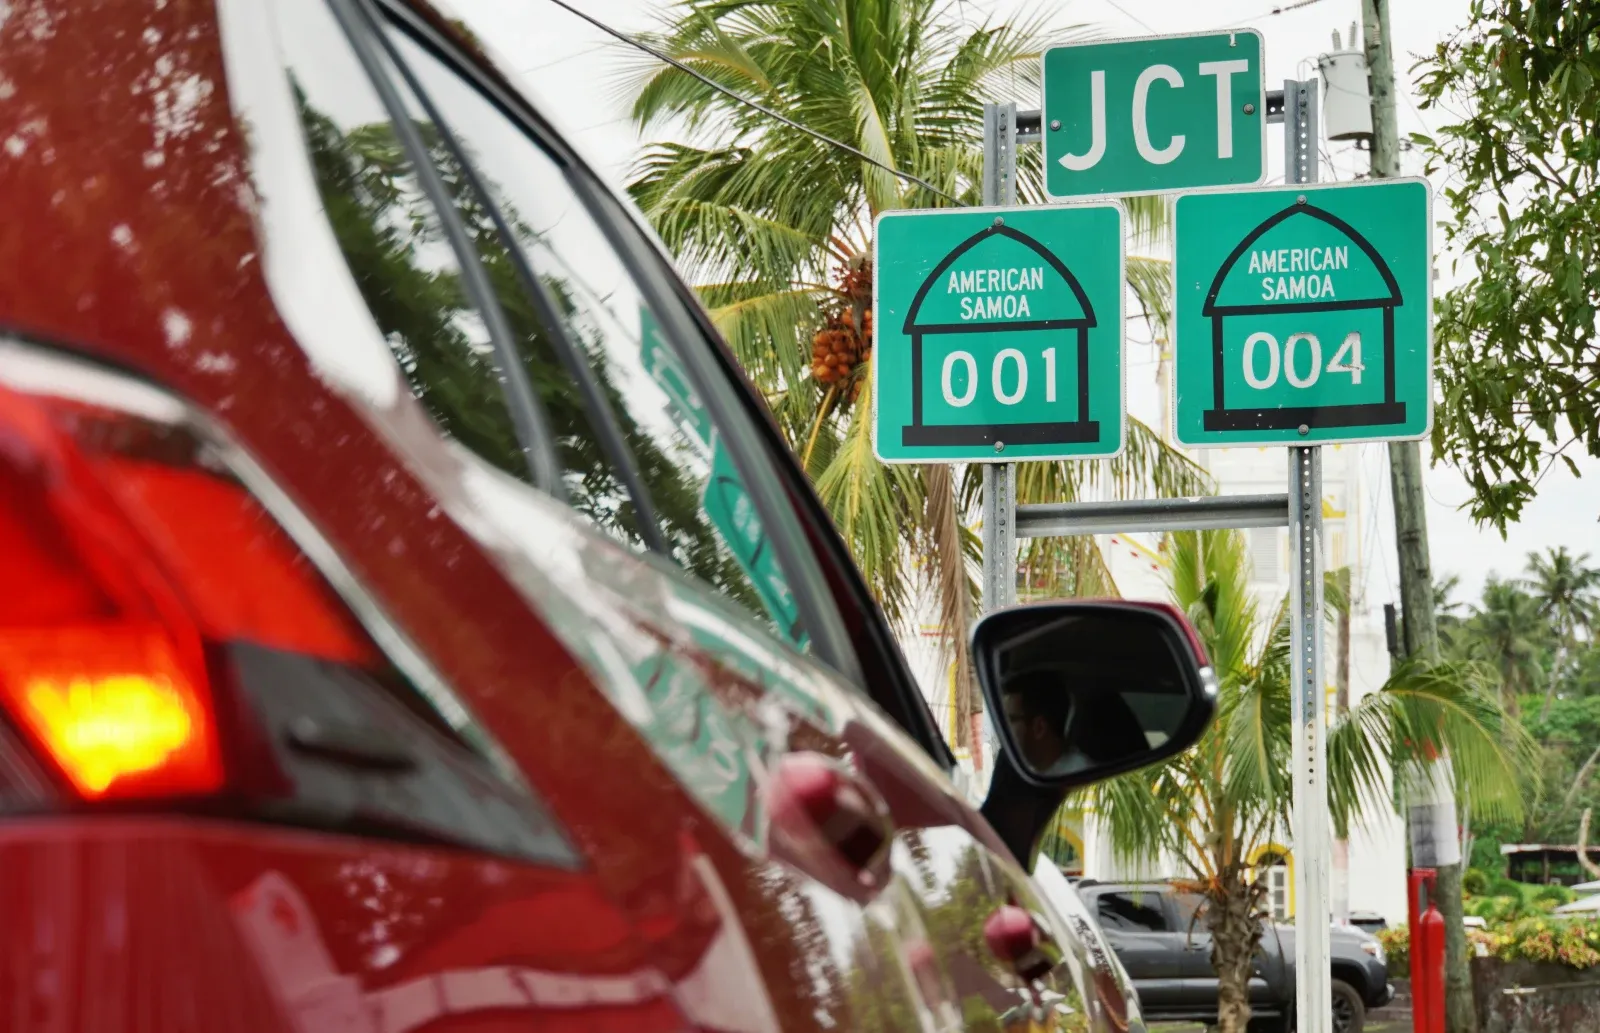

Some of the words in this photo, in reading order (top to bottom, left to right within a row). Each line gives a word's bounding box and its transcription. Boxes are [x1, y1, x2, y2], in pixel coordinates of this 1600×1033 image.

[1057, 58, 1249, 172] JCT
[1248, 246, 1349, 274] AMERICAN
[947, 267, 1044, 294] AMERICAN
[1261, 274, 1336, 301] SAMOA
[959, 294, 1031, 321] SAMOA
[1242, 331, 1366, 390] 004
[941, 347, 1057, 408] 001
